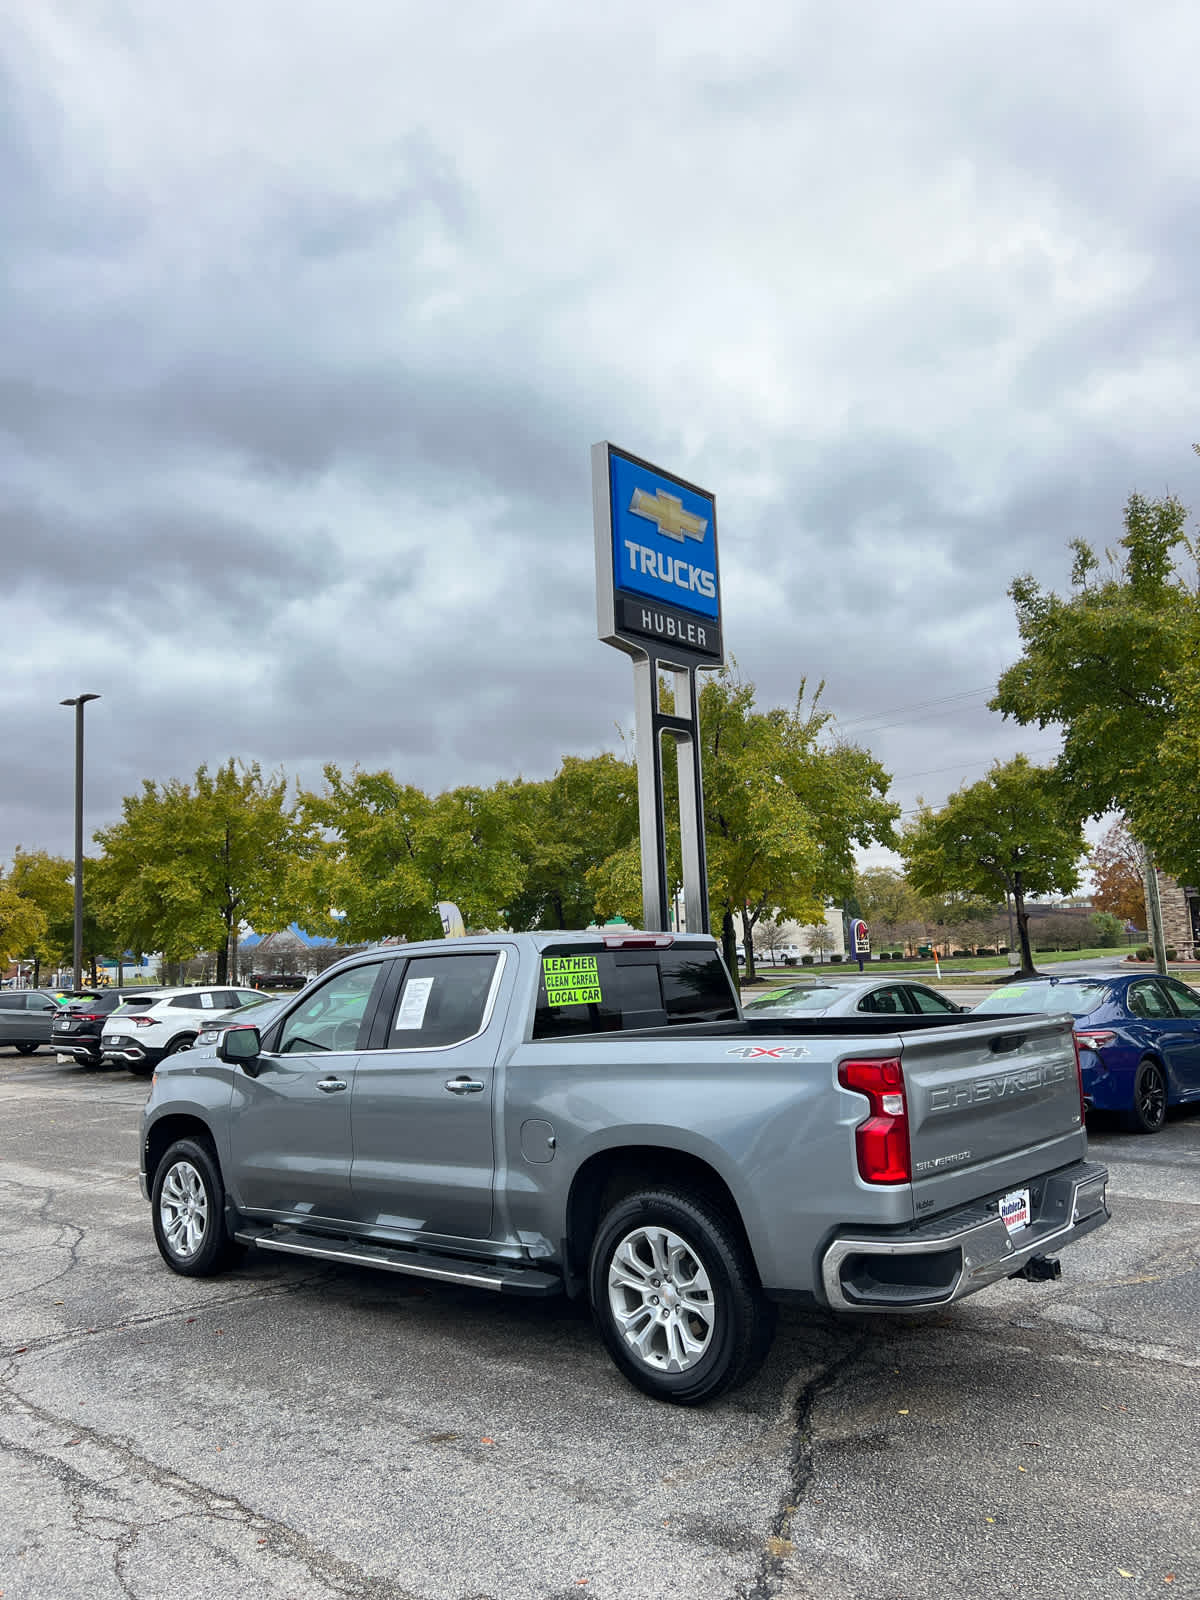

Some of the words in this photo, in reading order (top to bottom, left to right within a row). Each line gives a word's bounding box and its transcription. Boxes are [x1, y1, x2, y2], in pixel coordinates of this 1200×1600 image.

[624, 539, 716, 599] TRUCKS
[641, 609, 706, 646] HUBLER
[545, 957, 595, 971] LEATHER
[546, 975, 569, 988] CLEAN
[571, 973, 598, 986] CARFAX
[549, 991, 579, 1004] LOCAL
[581, 989, 600, 1001] CAR
[727, 1047, 808, 1058] 4X4
[930, 1060, 1076, 1111] CHEVROLET
[916, 1151, 971, 1170] SILVERADO
